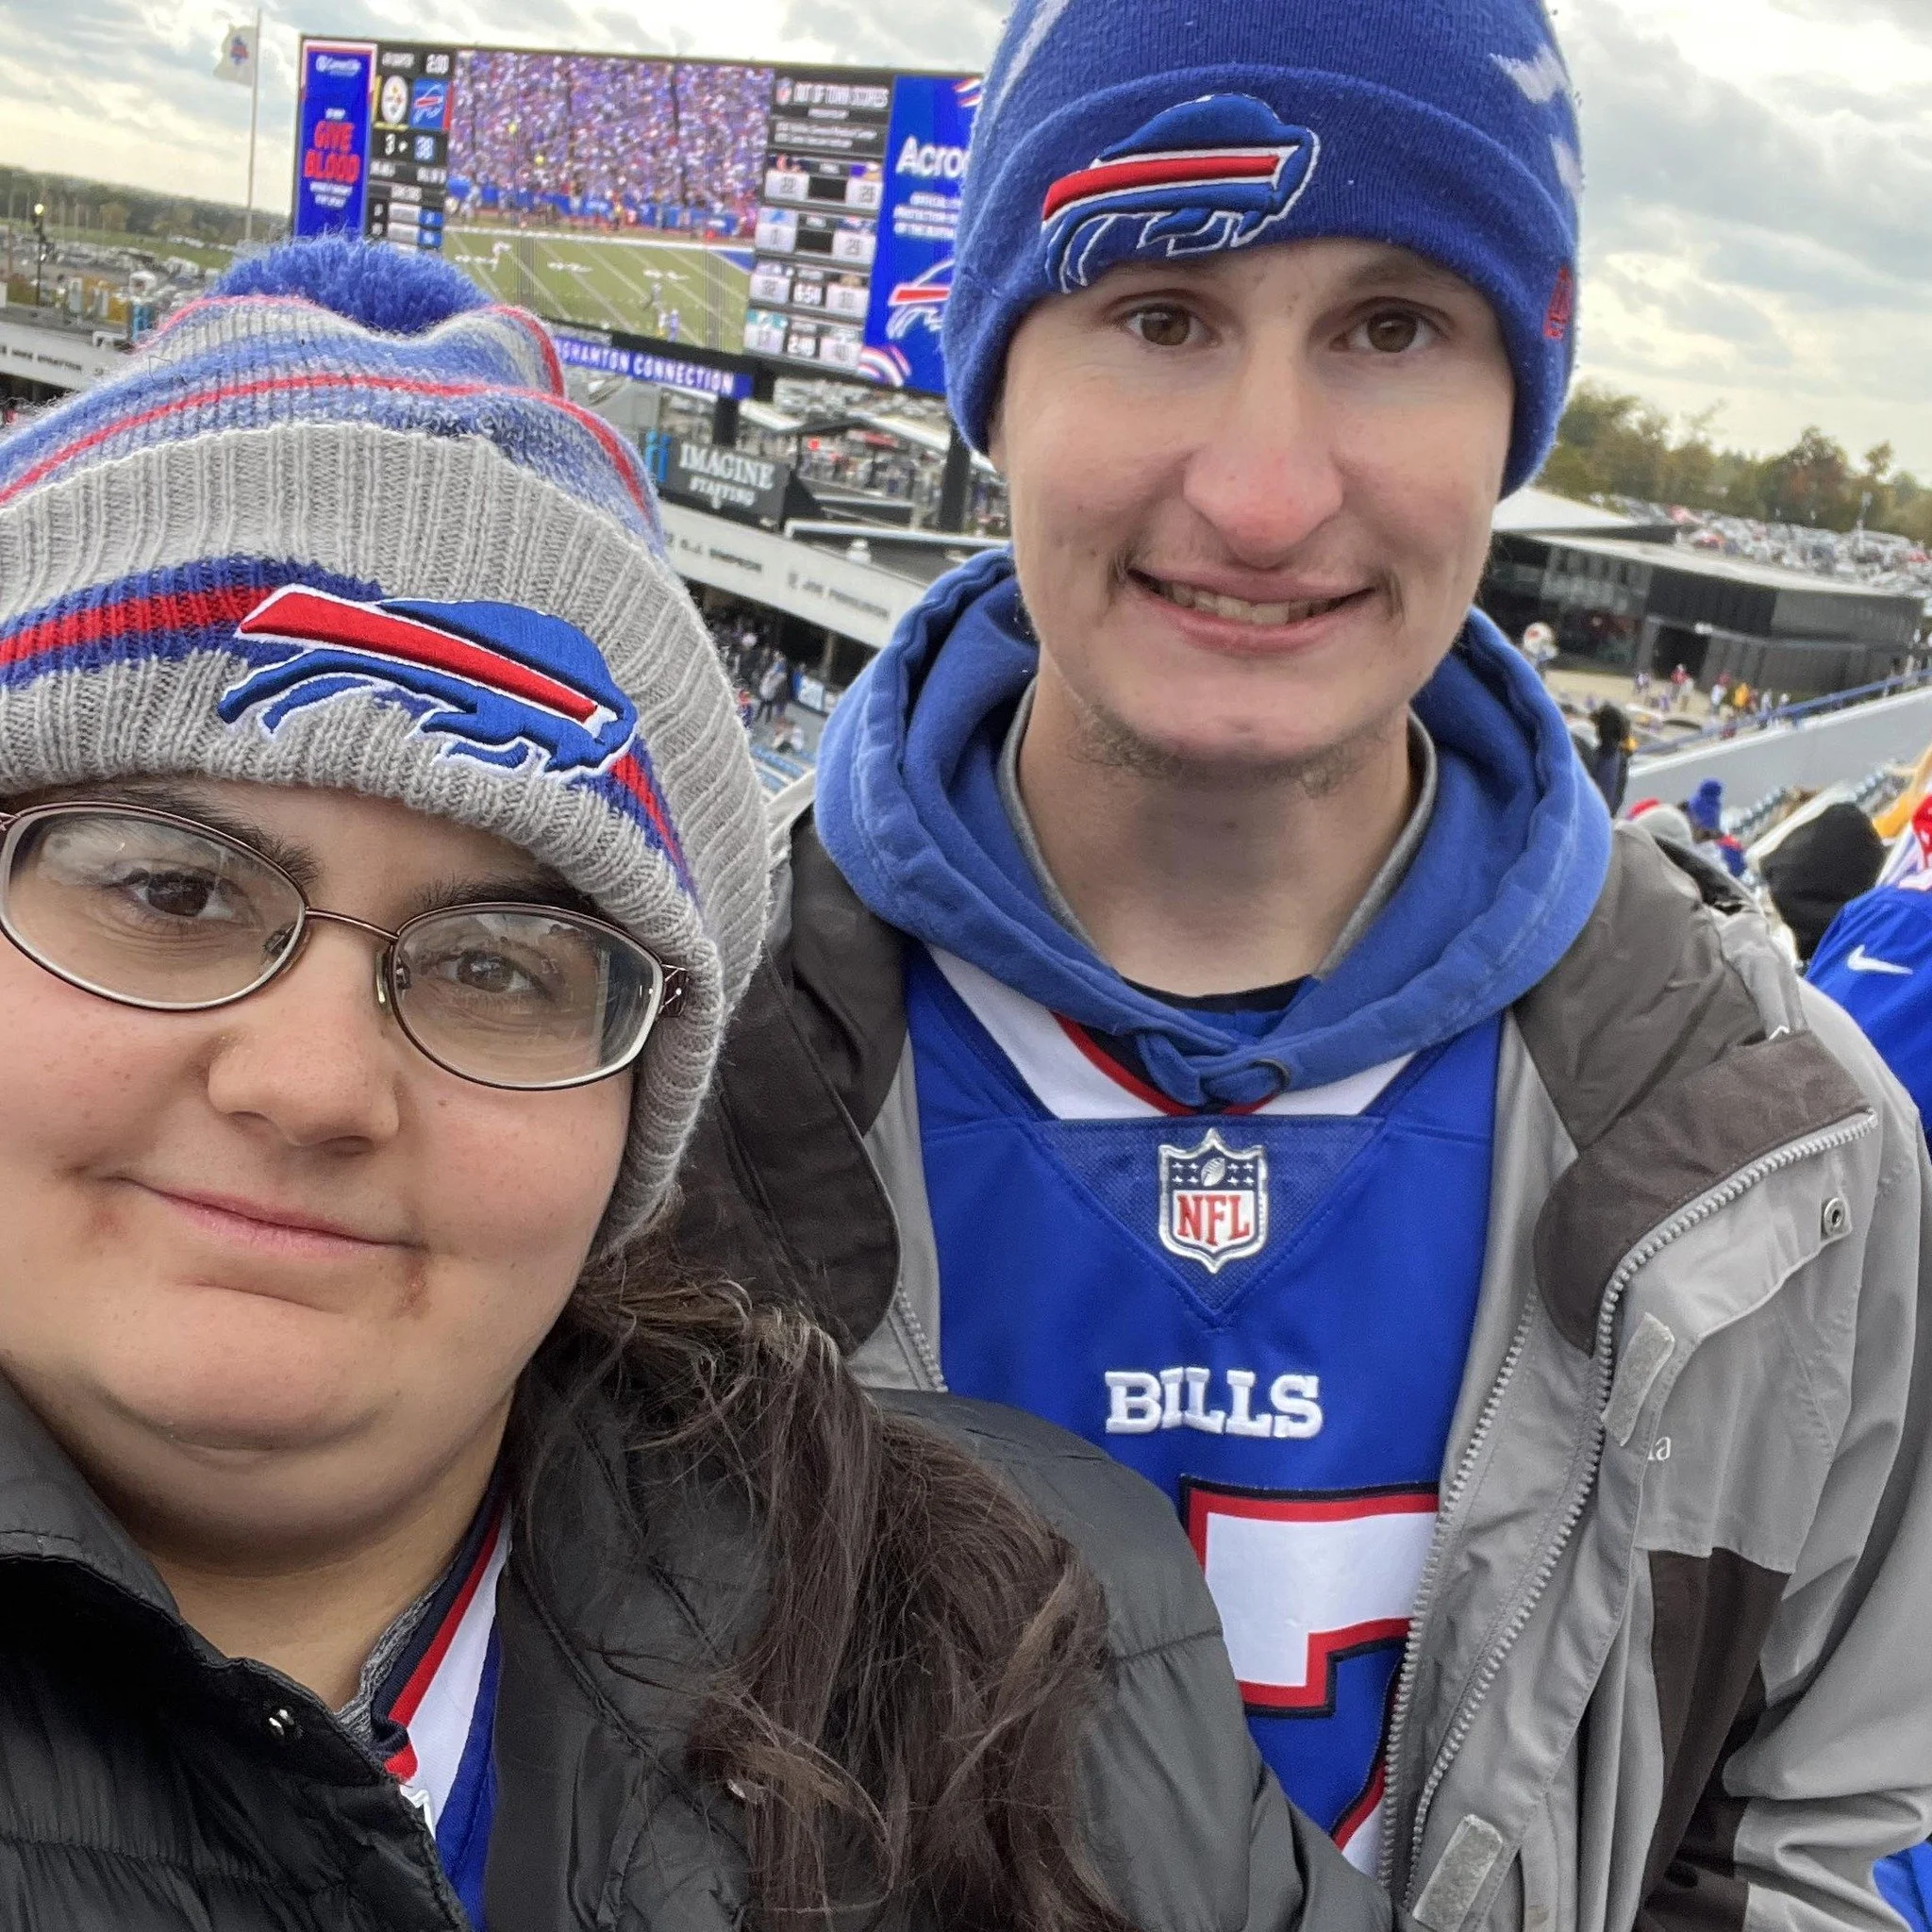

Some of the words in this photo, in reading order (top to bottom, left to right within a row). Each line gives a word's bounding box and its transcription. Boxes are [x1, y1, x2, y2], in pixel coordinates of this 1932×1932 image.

[633, 351, 734, 395] CONNECTION
[679, 443, 775, 491] IMAGINE
[1175, 1193, 1251, 1247] NFL
[1105, 1367, 1324, 1439] BILLS
